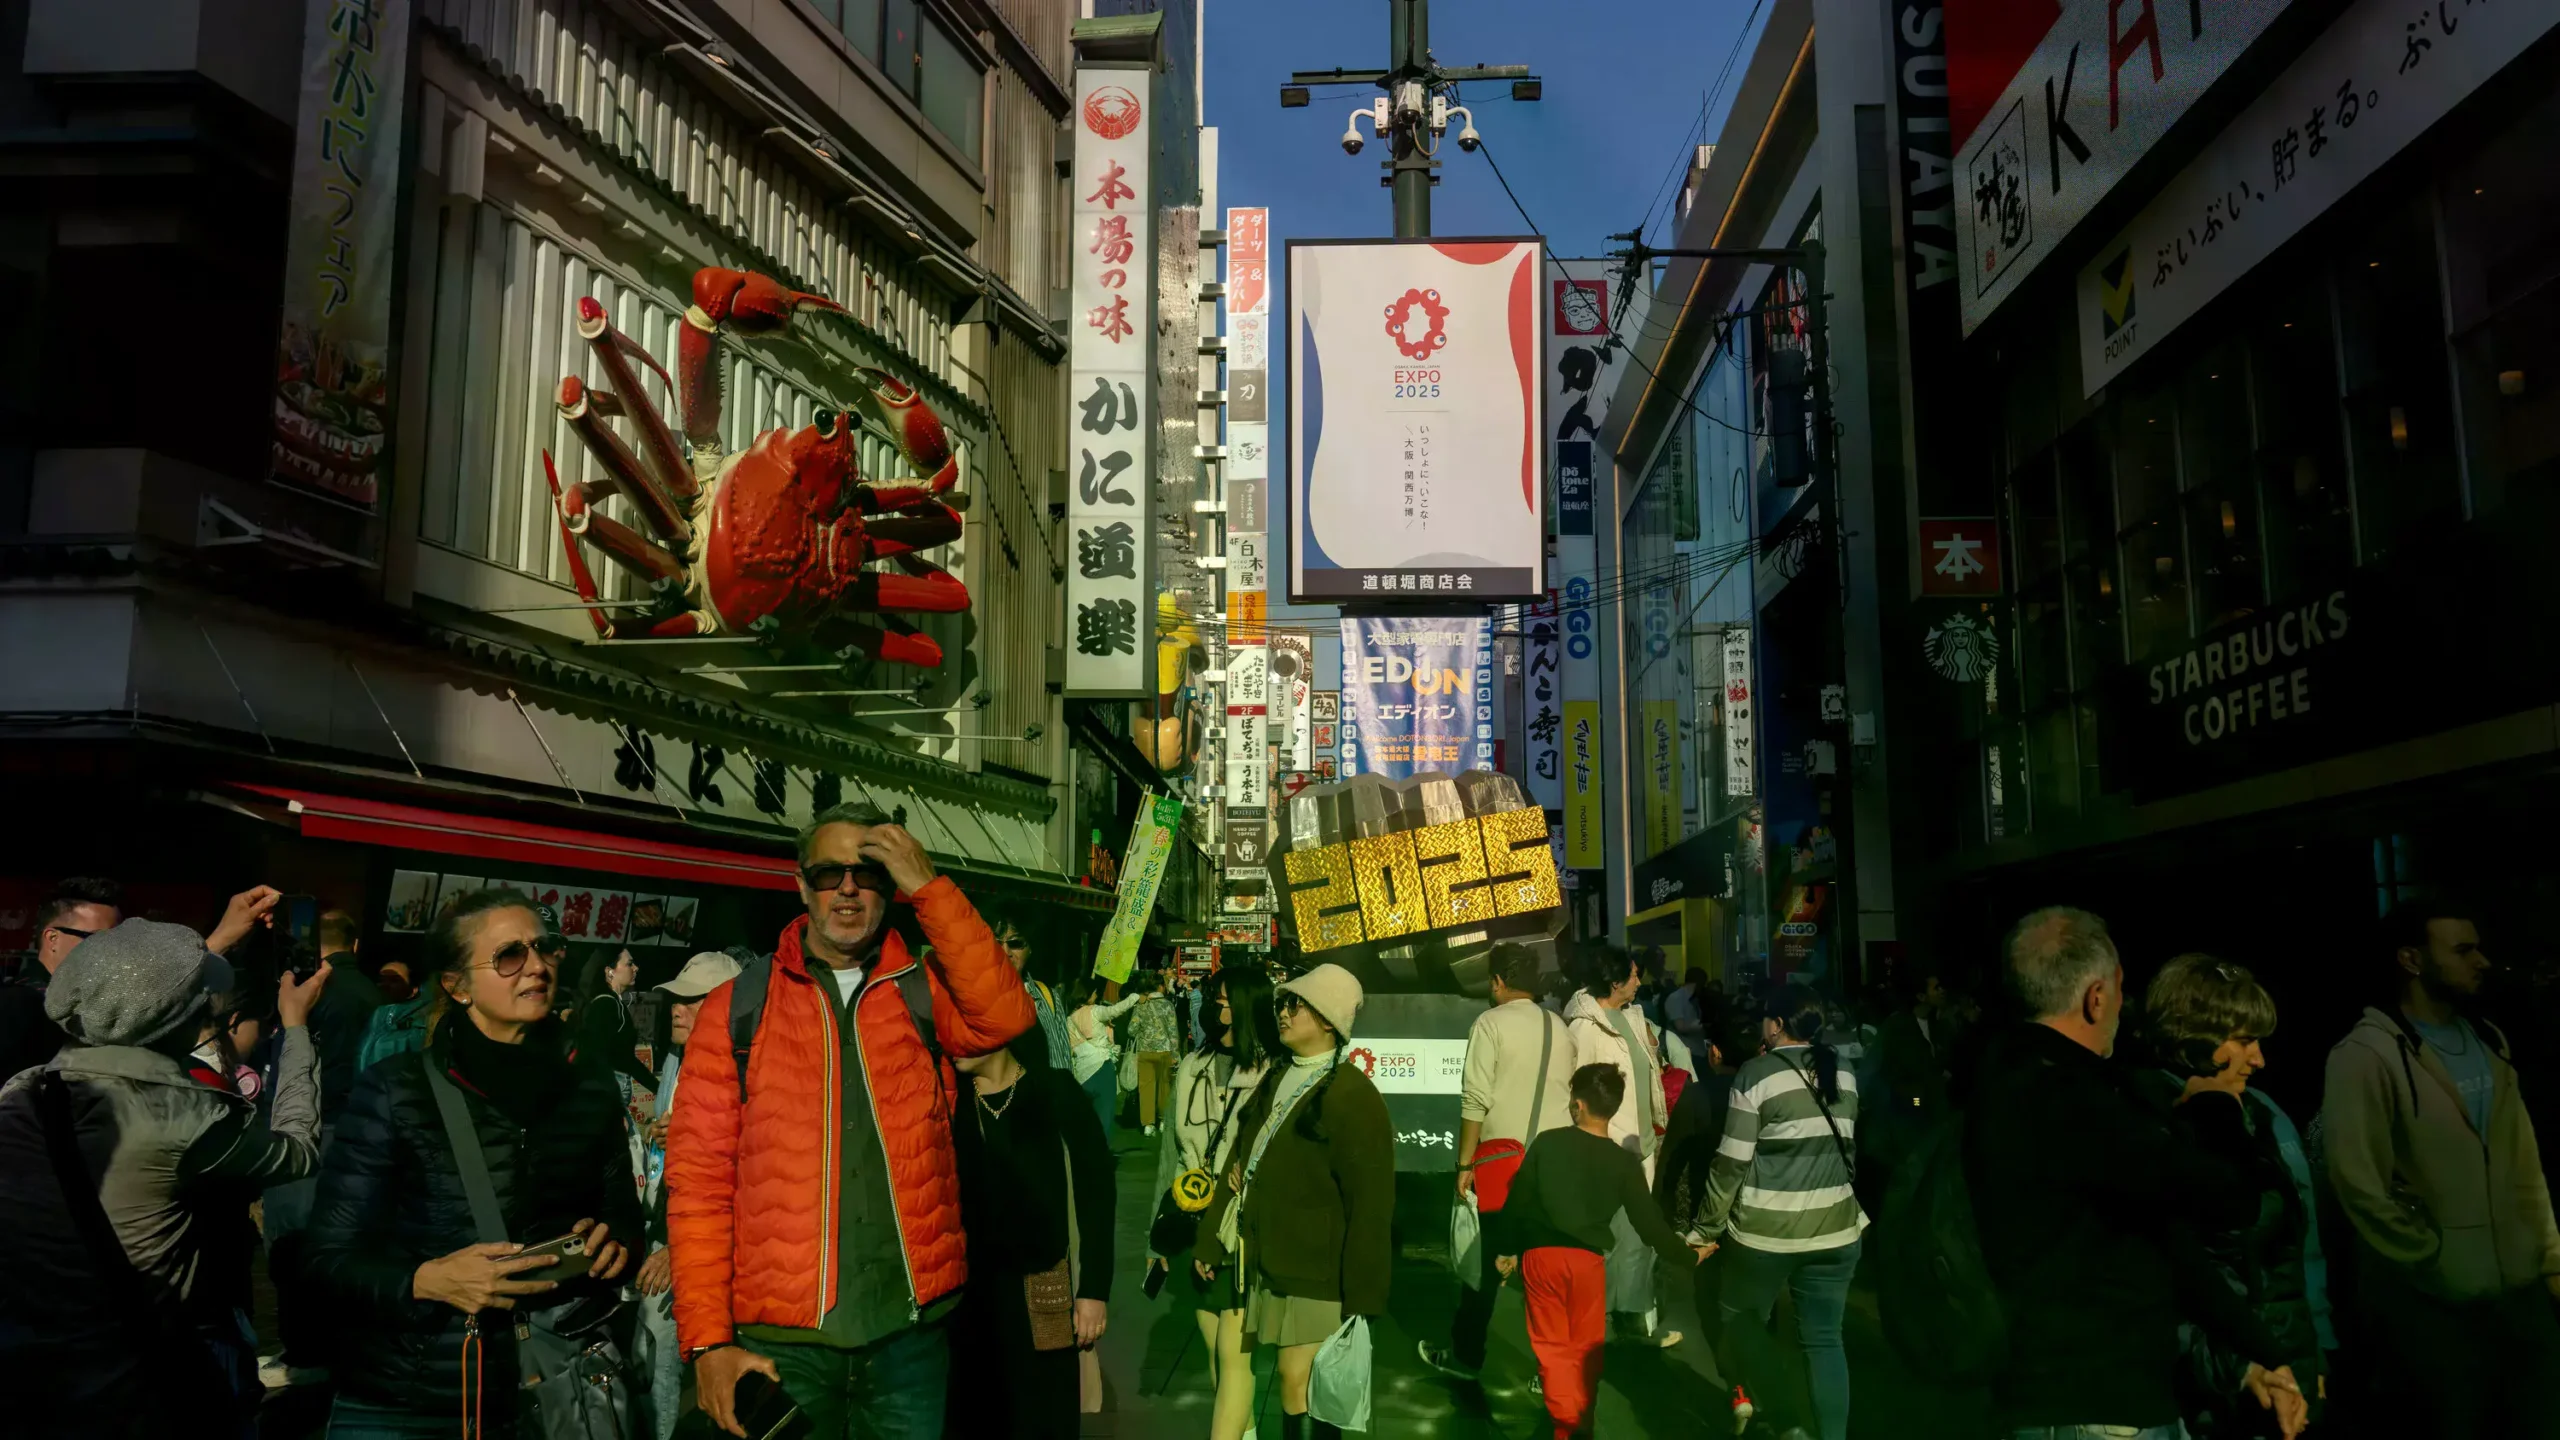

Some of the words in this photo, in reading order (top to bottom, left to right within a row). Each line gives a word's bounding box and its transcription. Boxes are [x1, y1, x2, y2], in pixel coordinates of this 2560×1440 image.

[1250, 214, 1263, 252] ダーツ
[1085, 158, 1135, 344] 本場の味
[1233, 214, 1246, 313] ダイニングバー
[1250, 267, 1263, 281] &
[2104, 323, 2137, 363] POINT
[1395, 370, 1441, 383] EXPO
[1395, 385, 1441, 398] 2025
[1076, 376, 1139, 657] かに道楽
[1229, 537, 1239, 546] 4F
[1240, 540, 1264, 586] 白木屋
[1932, 532, 1985, 582] 本
[1363, 574, 1473, 590] 道頓堀商店会
[2149, 590, 2348, 706] STARBUCKS
[1241, 706, 1254, 716] 2F
[1314, 699, 1335, 716] 牛角
[1377, 704, 1456, 720] エディオン
[2184, 667, 2311, 746] COFFEE
[1573, 719, 1591, 794] マツモトキヨシ
[1284, 804, 1562, 954] 2025
[1380, 1057, 1416, 1066] EXPO
[1381, 1067, 1416, 1077] 2025
[1442, 1057, 1466, 1065] MEE
